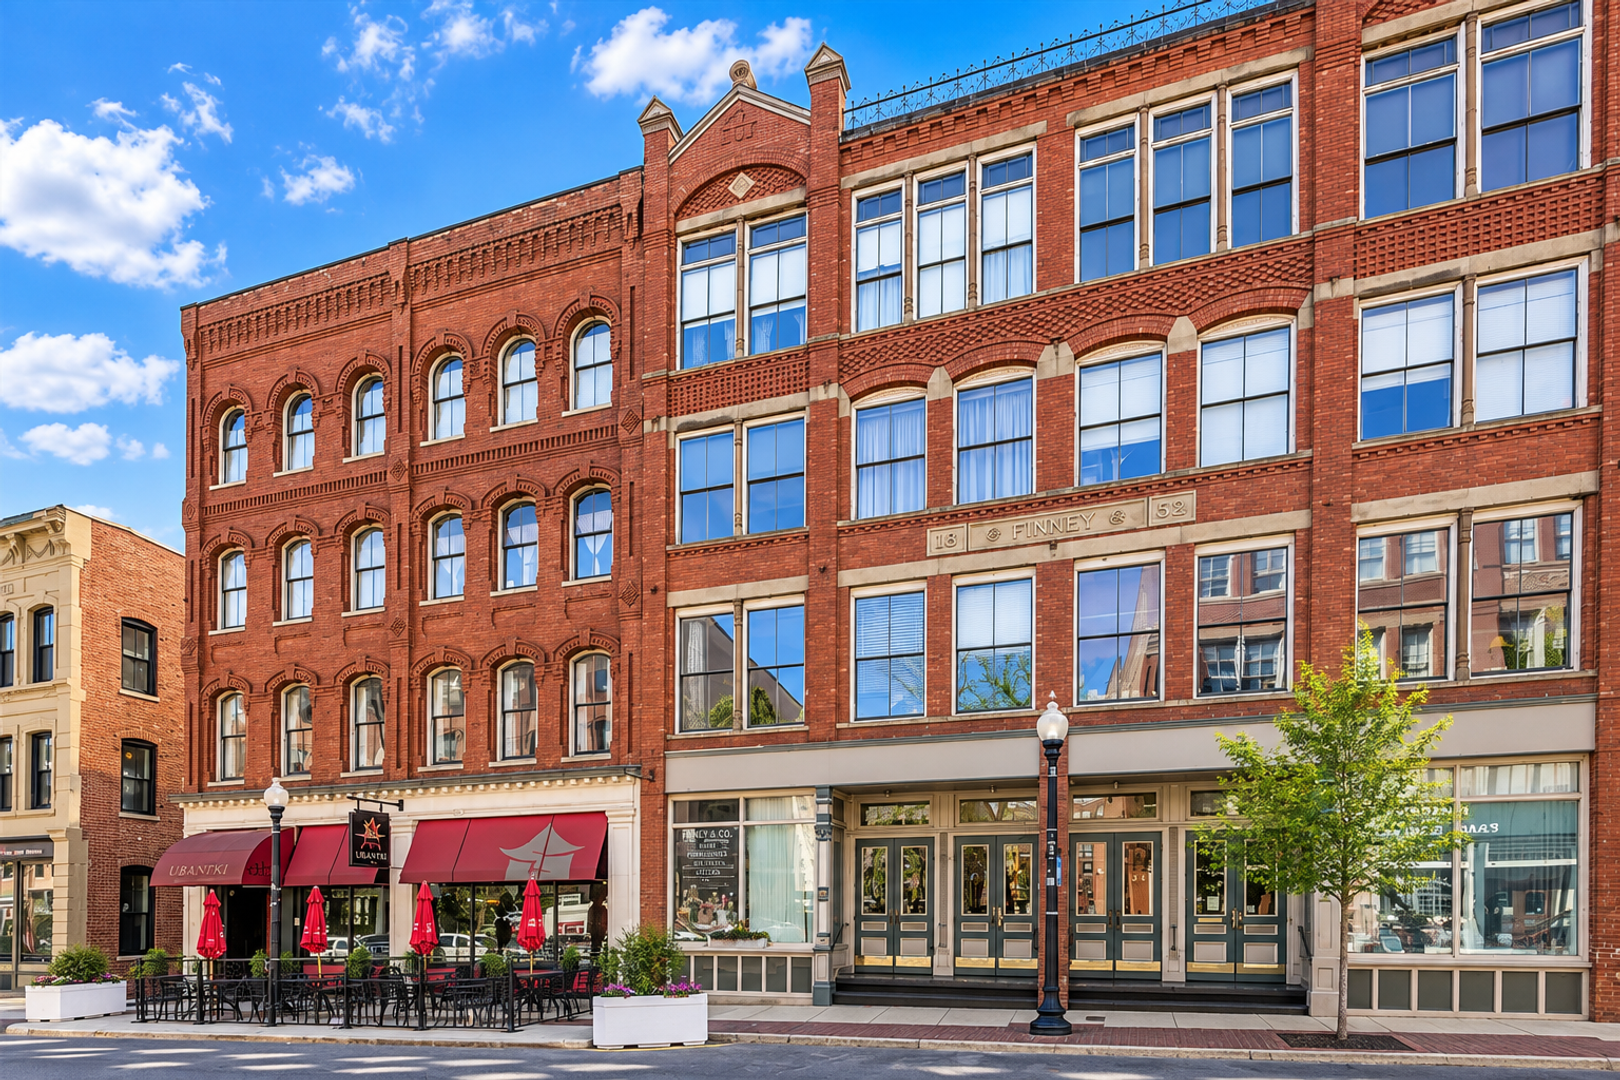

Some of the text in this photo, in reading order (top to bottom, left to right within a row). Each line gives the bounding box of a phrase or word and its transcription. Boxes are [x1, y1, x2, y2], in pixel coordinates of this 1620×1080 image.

[936, 532, 957, 550] 18
[1012, 511, 1096, 540] FINNEY
[1156, 499, 1188, 518] 52
